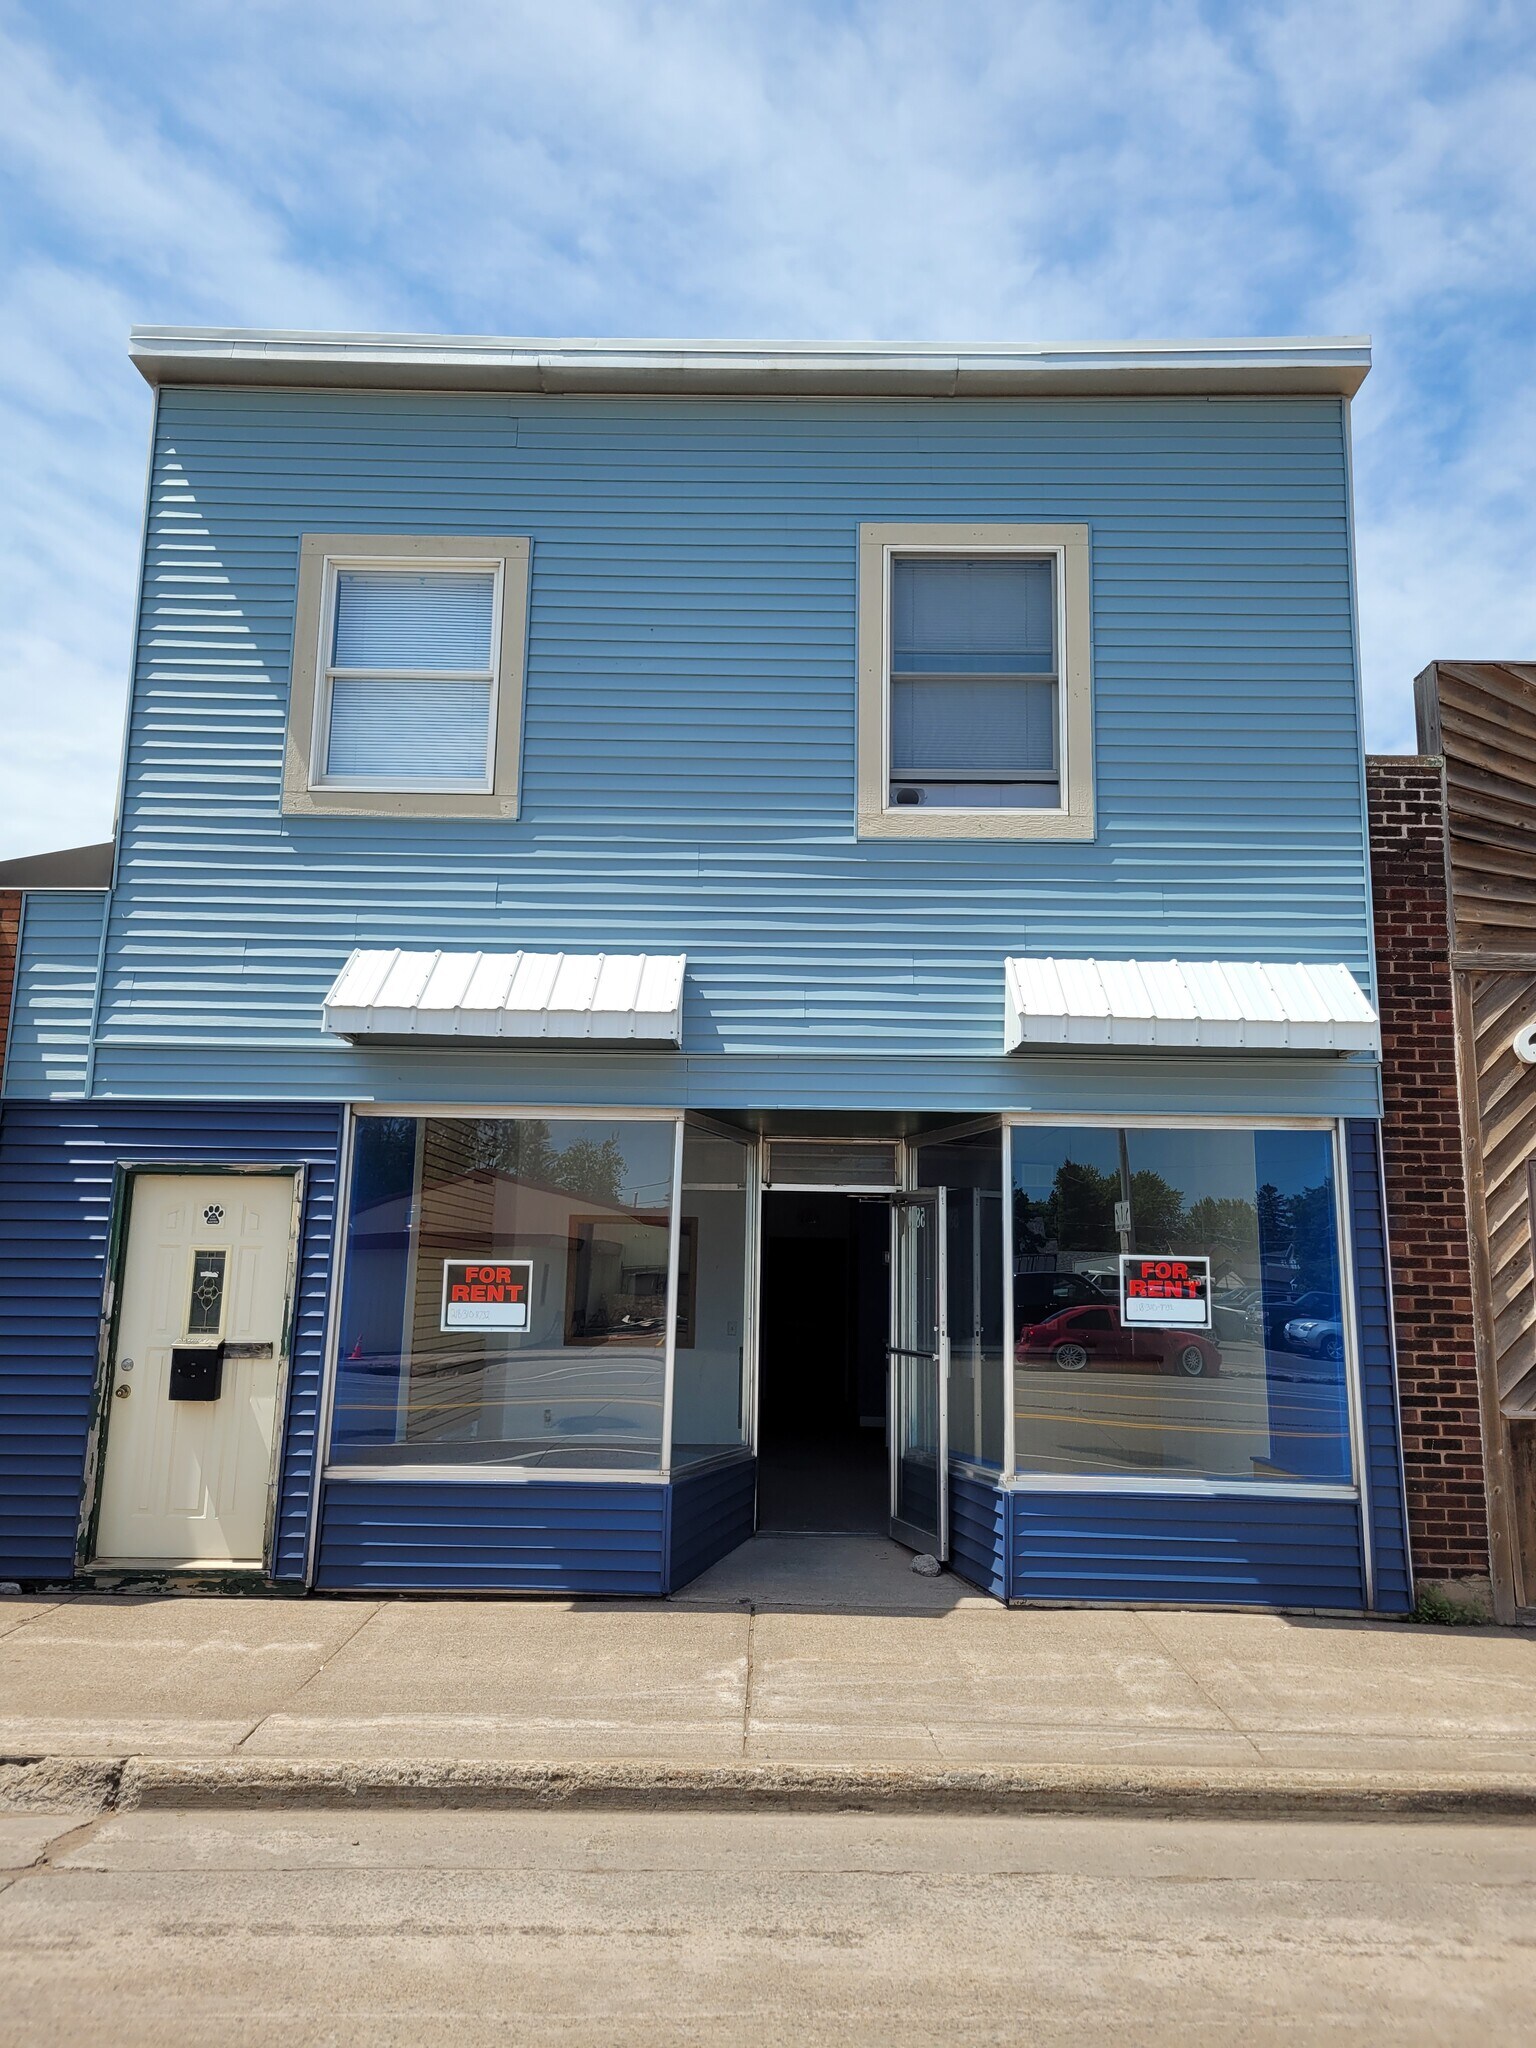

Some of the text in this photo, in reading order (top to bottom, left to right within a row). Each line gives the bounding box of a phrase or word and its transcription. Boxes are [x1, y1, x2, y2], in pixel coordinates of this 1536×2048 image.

[465, 1267, 511, 1283] FOR
[1141, 1261, 1188, 1279] FOR
[451, 1285, 524, 1302] RENT
[1129, 1279, 1201, 1298] RENT
